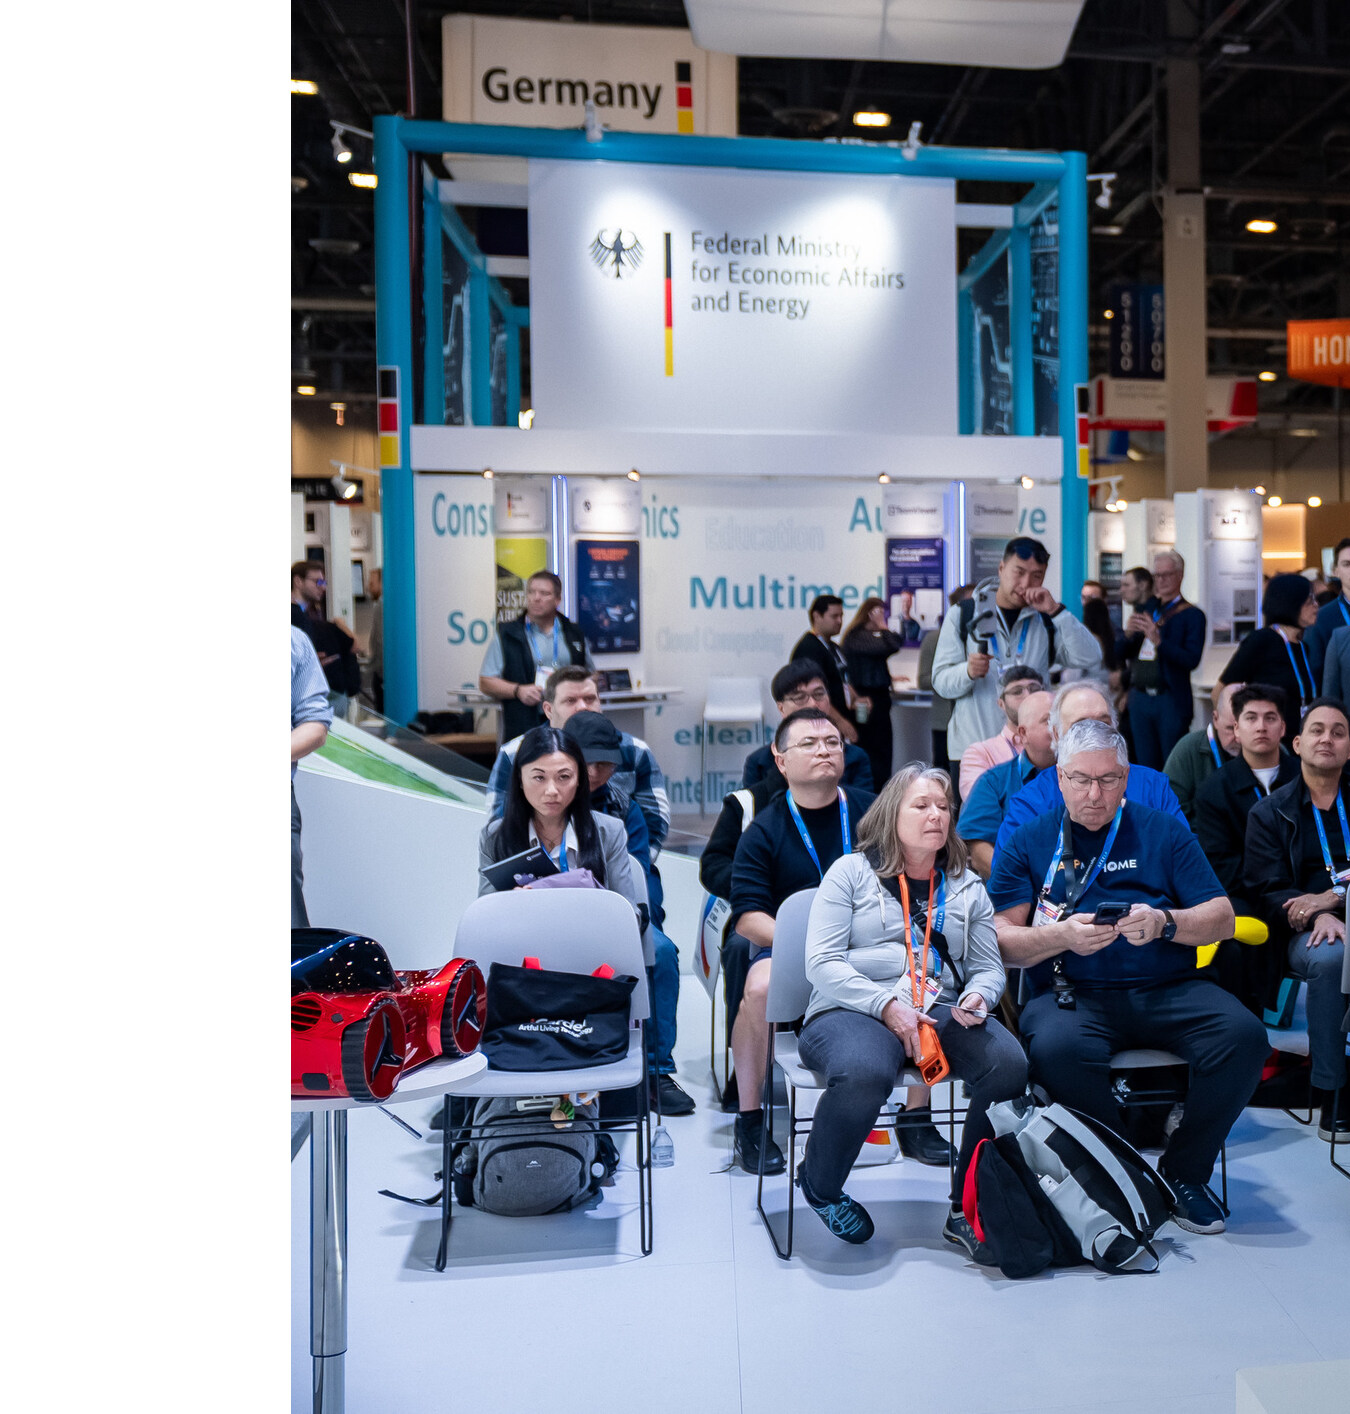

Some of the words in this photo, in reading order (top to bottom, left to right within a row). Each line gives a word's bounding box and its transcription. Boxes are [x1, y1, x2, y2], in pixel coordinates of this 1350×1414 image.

[482, 66, 662, 119] Germany
[691, 231, 769, 256] Federal
[777, 235, 861, 260] Ministry
[691, 260, 720, 283] for
[728, 261, 831, 287] Economic
[838, 267, 905, 290] Affairs
[691, 291, 729, 313] and
[738, 290, 810, 320] Energy
[518, 1024, 539, 1032] Artful
[540, 1024, 560, 1033] Living
